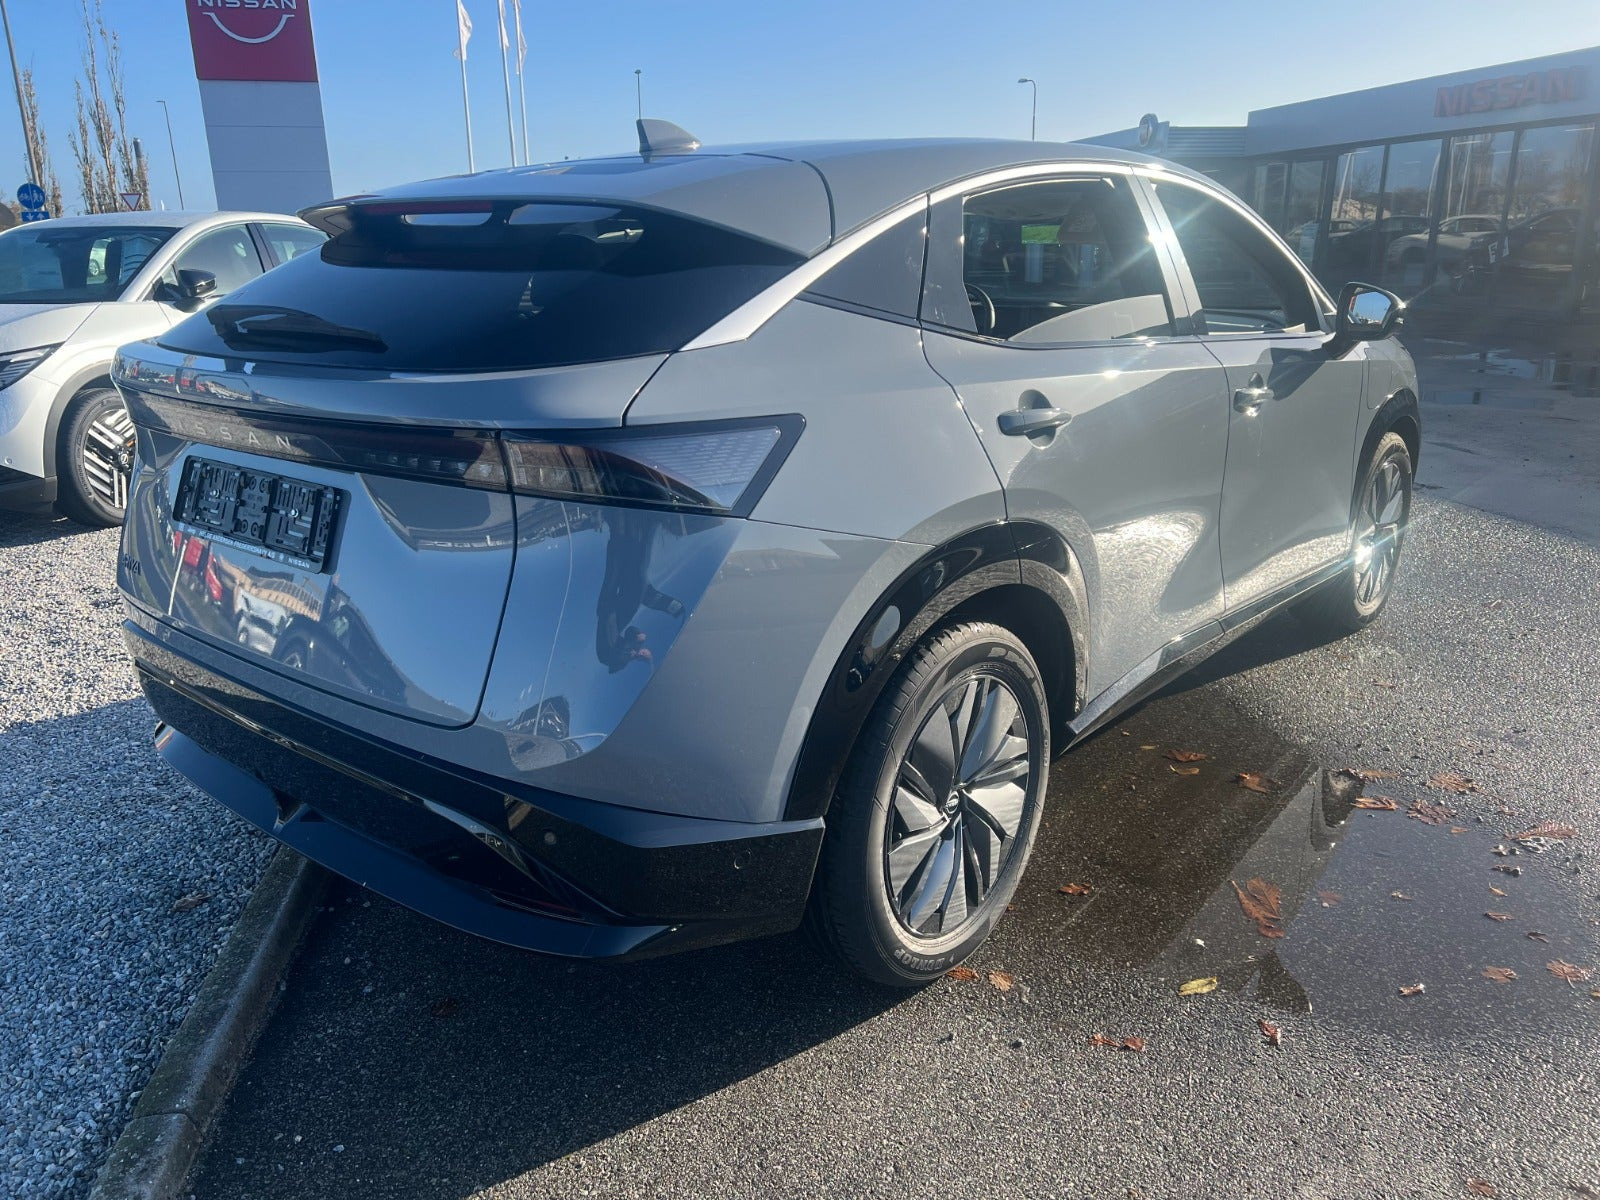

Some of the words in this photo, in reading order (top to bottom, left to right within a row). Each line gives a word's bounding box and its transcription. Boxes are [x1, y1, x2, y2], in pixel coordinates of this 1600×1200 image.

[1434, 67, 1586, 117] NISSAN
[166, 418, 292, 449] ISSAN
[288, 557, 309, 568] NISSAN
[893, 948, 946, 971] DUNLOP
